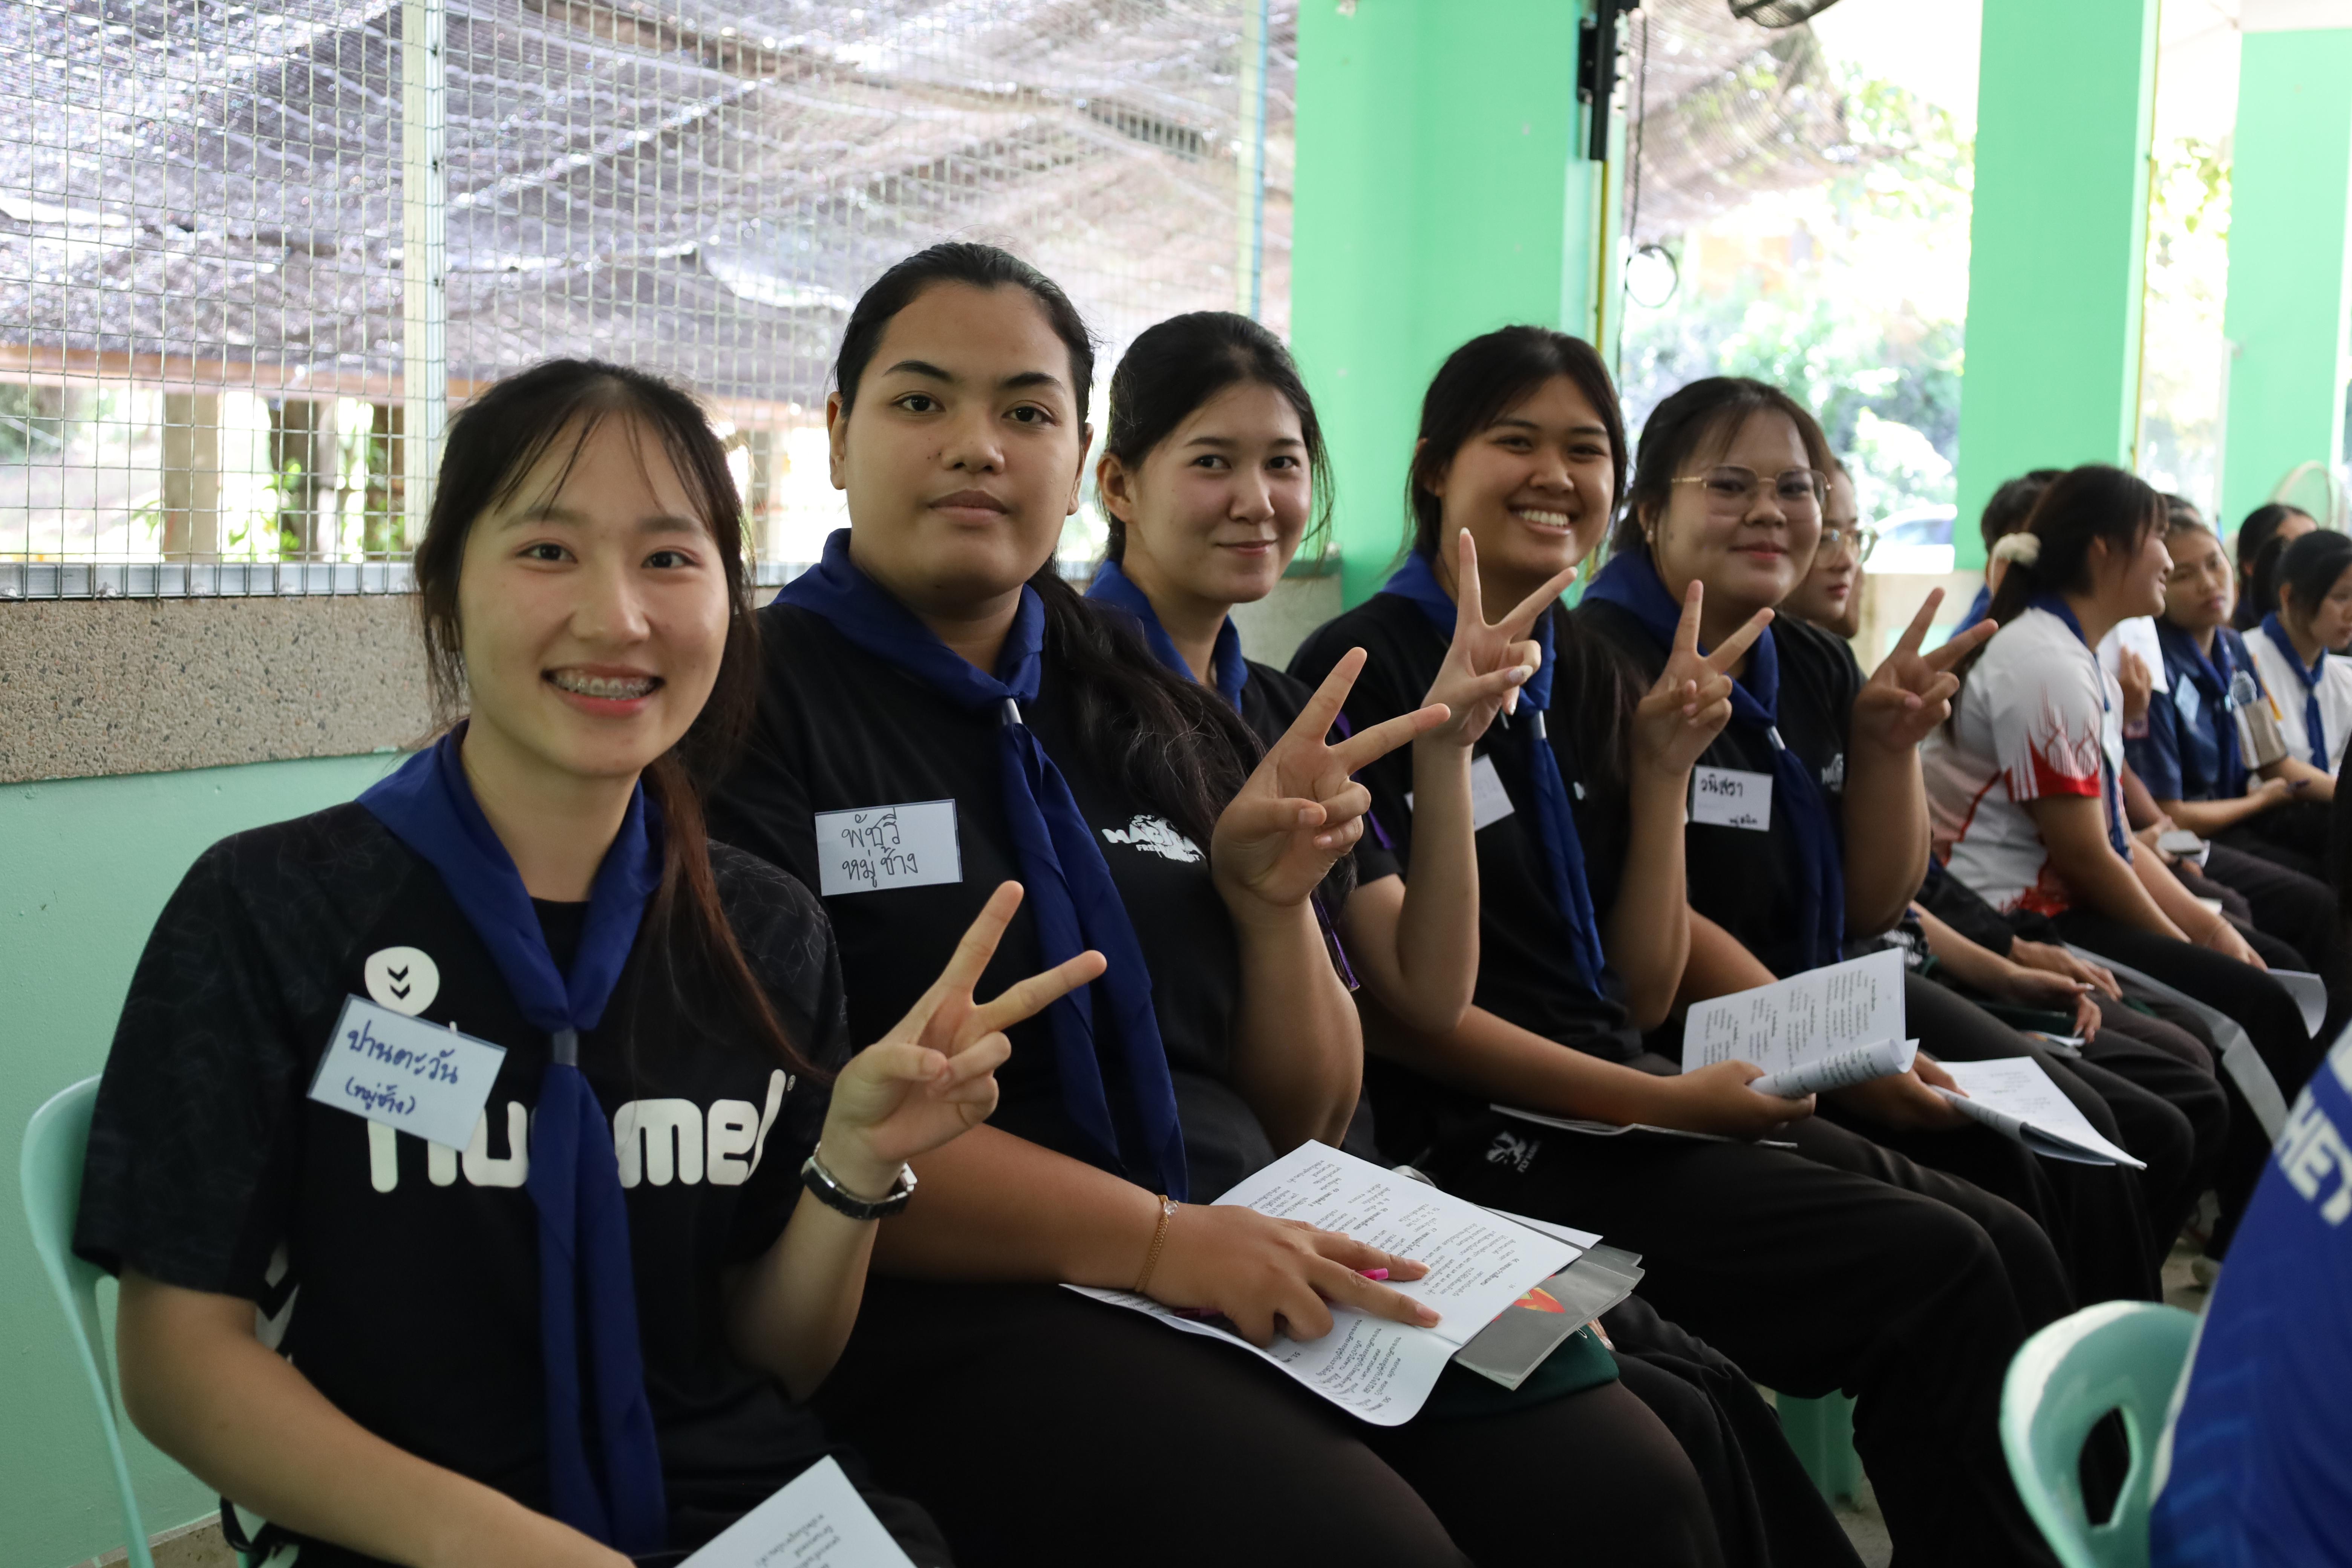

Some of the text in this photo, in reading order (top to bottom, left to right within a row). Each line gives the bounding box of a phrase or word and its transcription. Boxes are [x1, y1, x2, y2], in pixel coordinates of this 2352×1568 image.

[348, 1020, 459, 1084] ปานตะวัน
[345, 1075, 416, 1115] (หมู่ช้าง)
[1398, 1231, 1430, 1256] เพลงแม่น้ำเจ้าพระ
